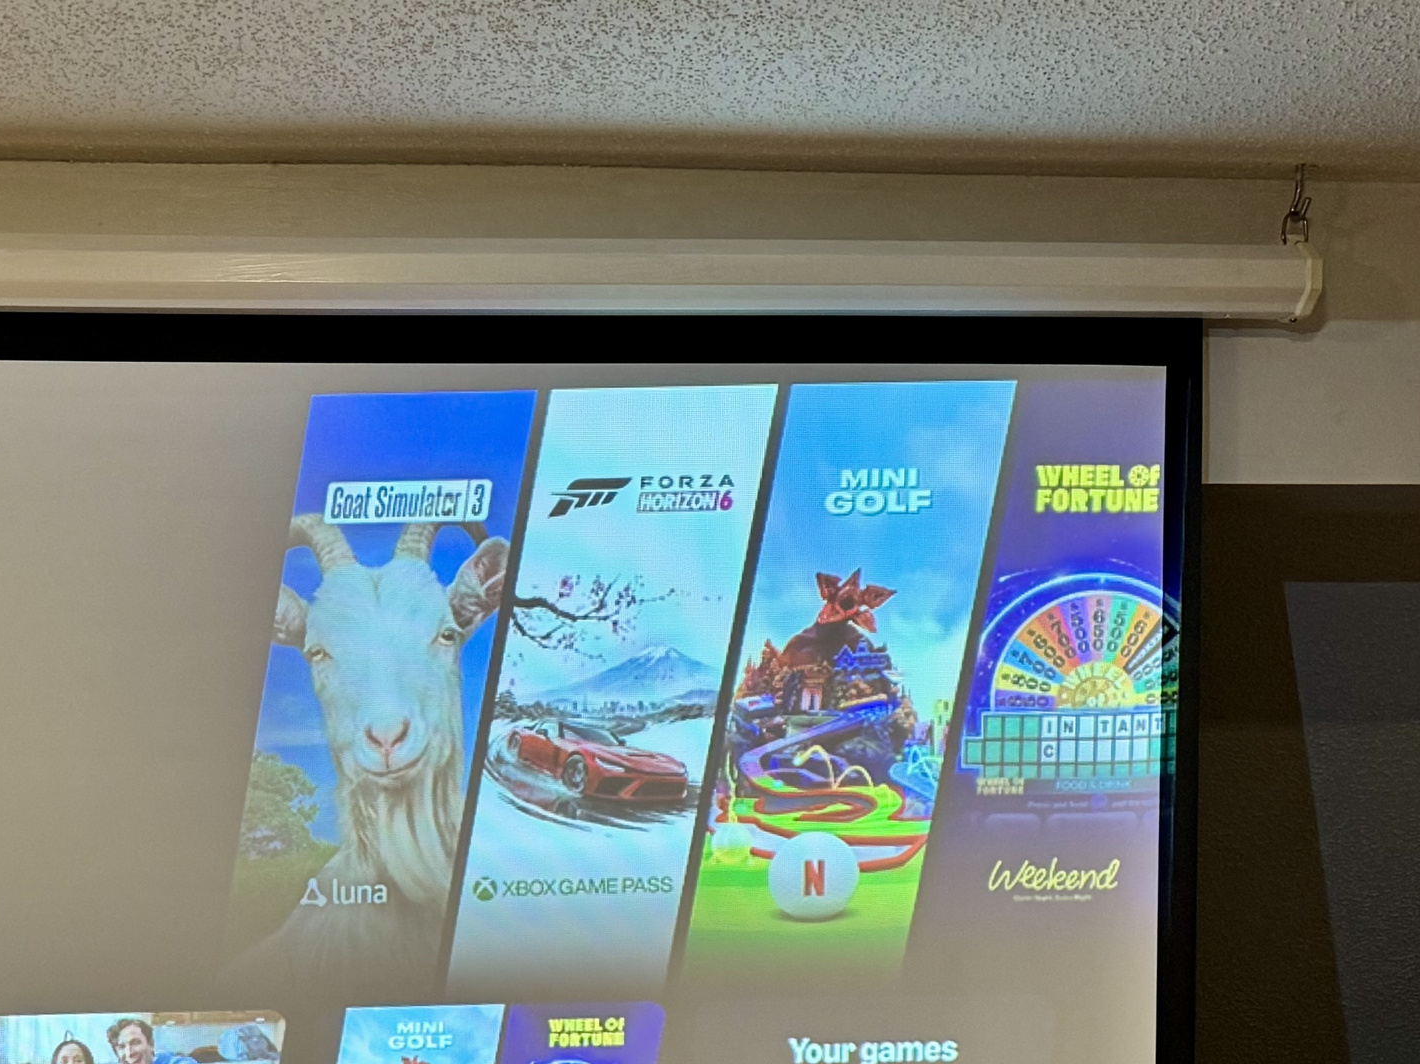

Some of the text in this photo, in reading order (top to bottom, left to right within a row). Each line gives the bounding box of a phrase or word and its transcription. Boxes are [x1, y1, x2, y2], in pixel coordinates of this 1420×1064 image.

[640, 474, 734, 489] FORZA
[841, 467, 919, 490] MINI
[1036, 464, 1125, 487] WHEEL
[331, 483, 485, 519] Goat Simulator 3
[638, 489, 734, 512] HORIZON 6
[825, 490, 932, 516] GOLF
[1036, 488, 1160, 513] FORTUNE
[803, 858, 825, 897] N
[988, 857, 1121, 891] Weekend
[333, 878, 388, 905] luna
[502, 877, 674, 896] XBOX GAME PASS
[397, 1021, 444, 1034] MINI
[548, 1017, 603, 1032] WHEEL
[388, 1034, 453, 1050] GOLF
[787, 1038, 857, 1064] Your
